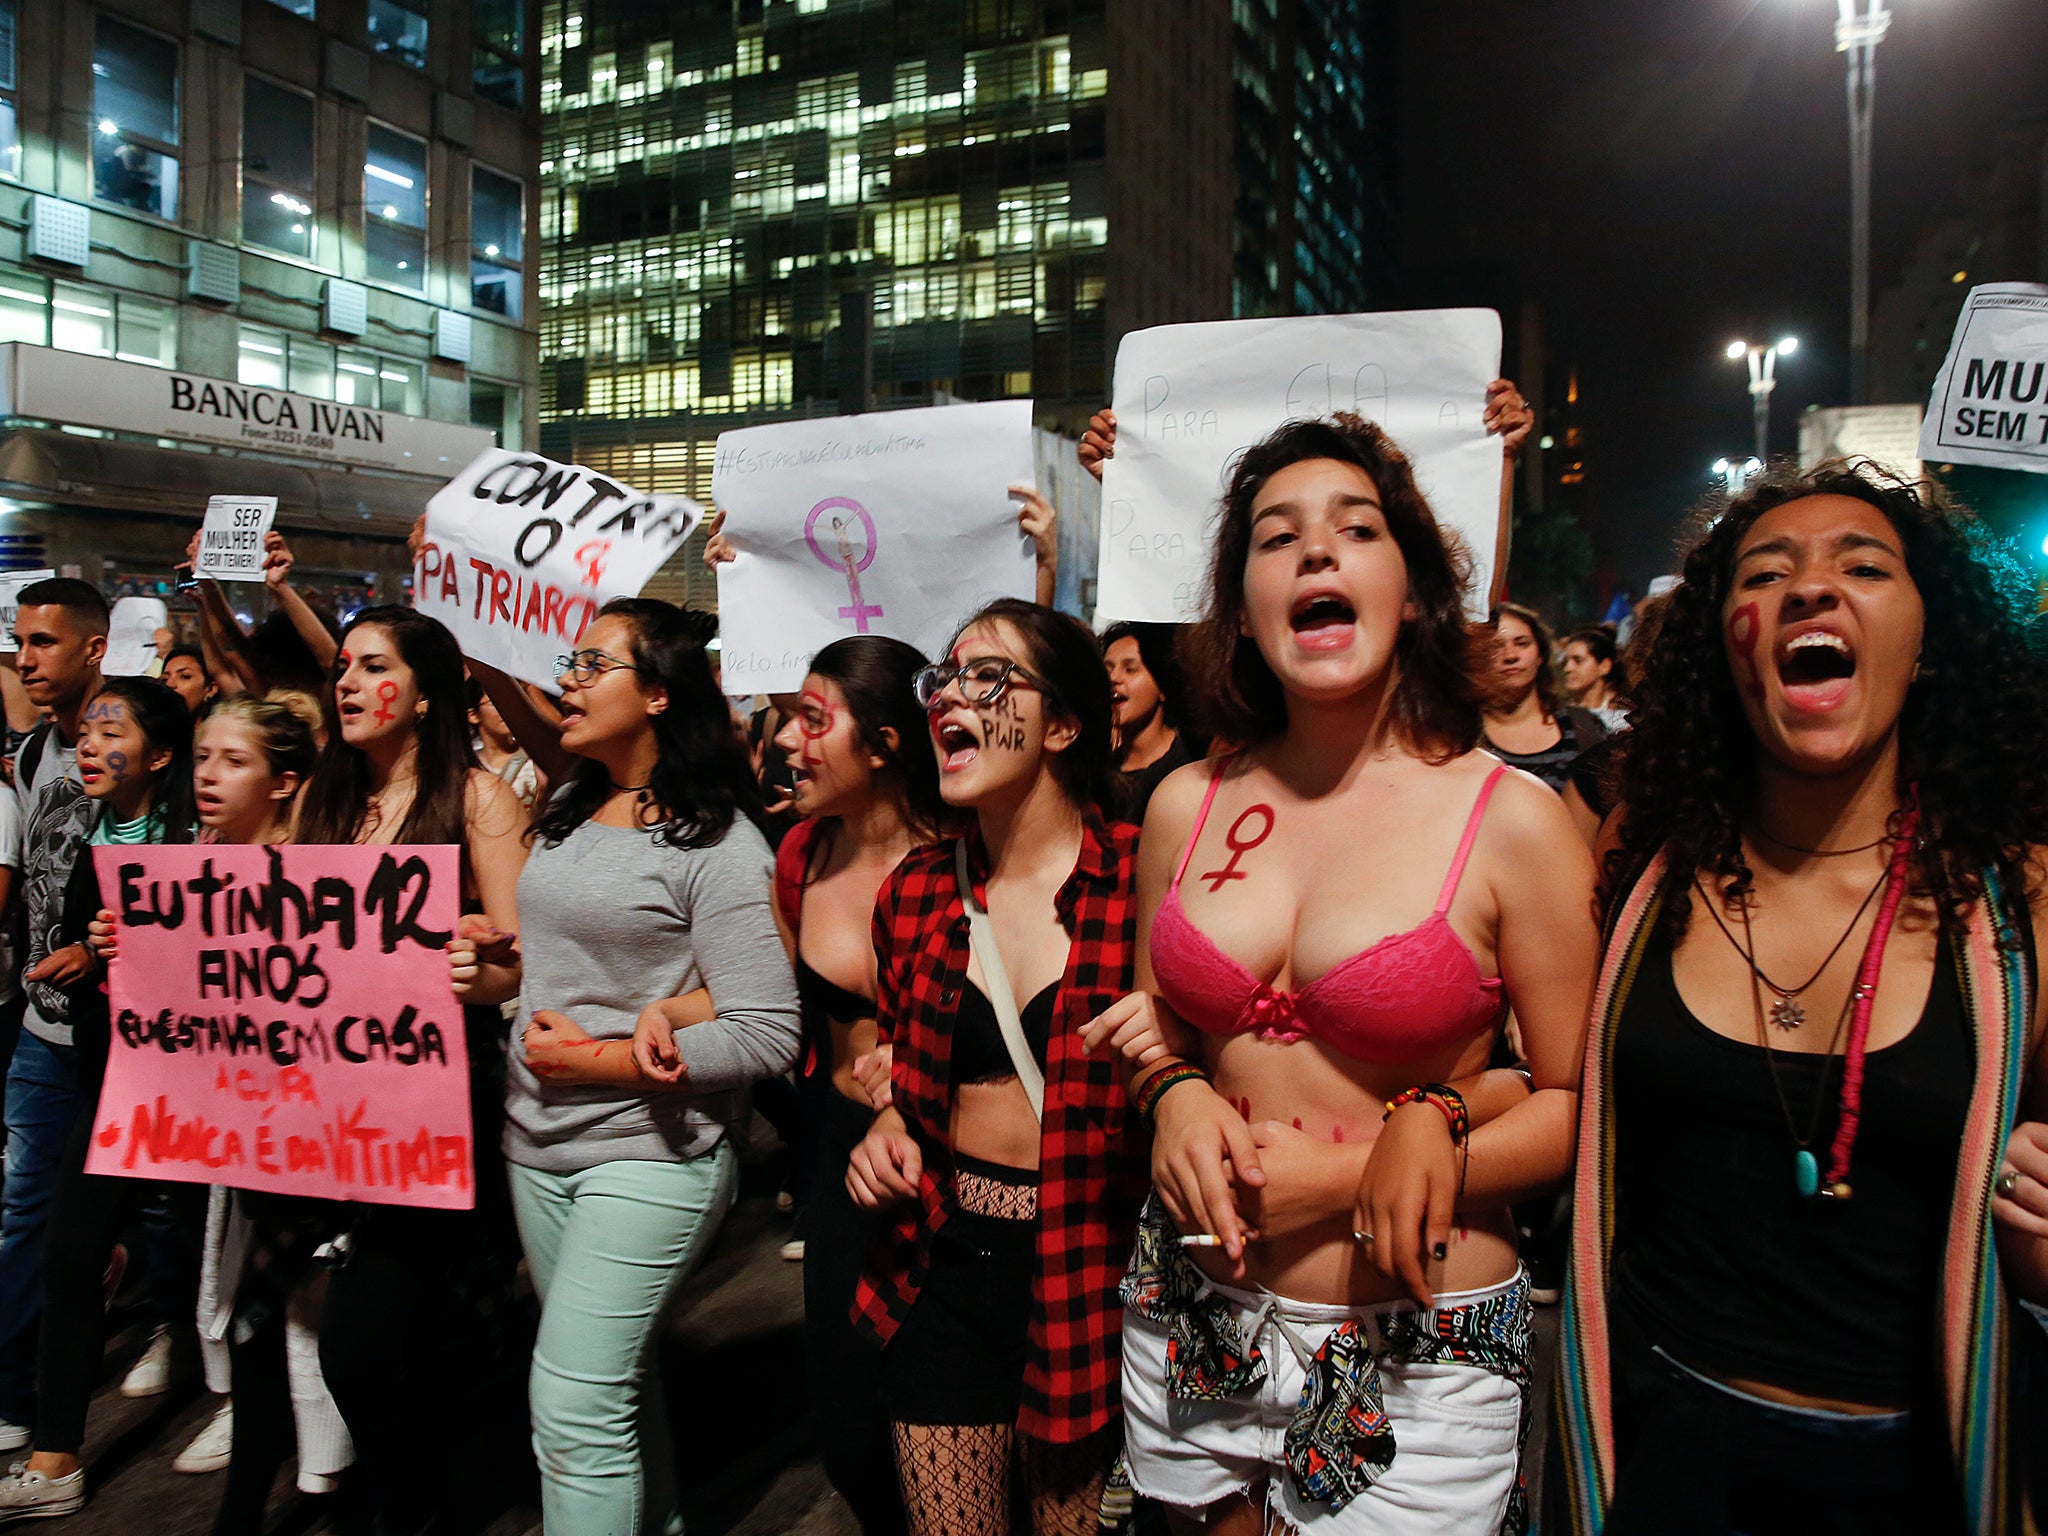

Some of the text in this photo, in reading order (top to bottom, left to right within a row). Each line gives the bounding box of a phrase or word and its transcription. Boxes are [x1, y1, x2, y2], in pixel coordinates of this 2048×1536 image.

[1143, 375, 1219, 440] PARA
[1963, 358, 2048, 404] MU
[171, 377, 383, 443] BANCA IVAN
[1953, 407, 2028, 443] SEM
[233, 508, 262, 528] SER
[472, 459, 694, 546] CONTRA
[202, 552, 221, 567] SEM
[204, 530, 258, 550] MULHER
[514, 518, 563, 567] O
[1107, 500, 1185, 564] PARA
[981, 718, 1026, 752] PWR
[364, 852, 453, 954] 12
[199, 943, 329, 1009] ANOS
[336, 1004, 446, 1067] CASA
